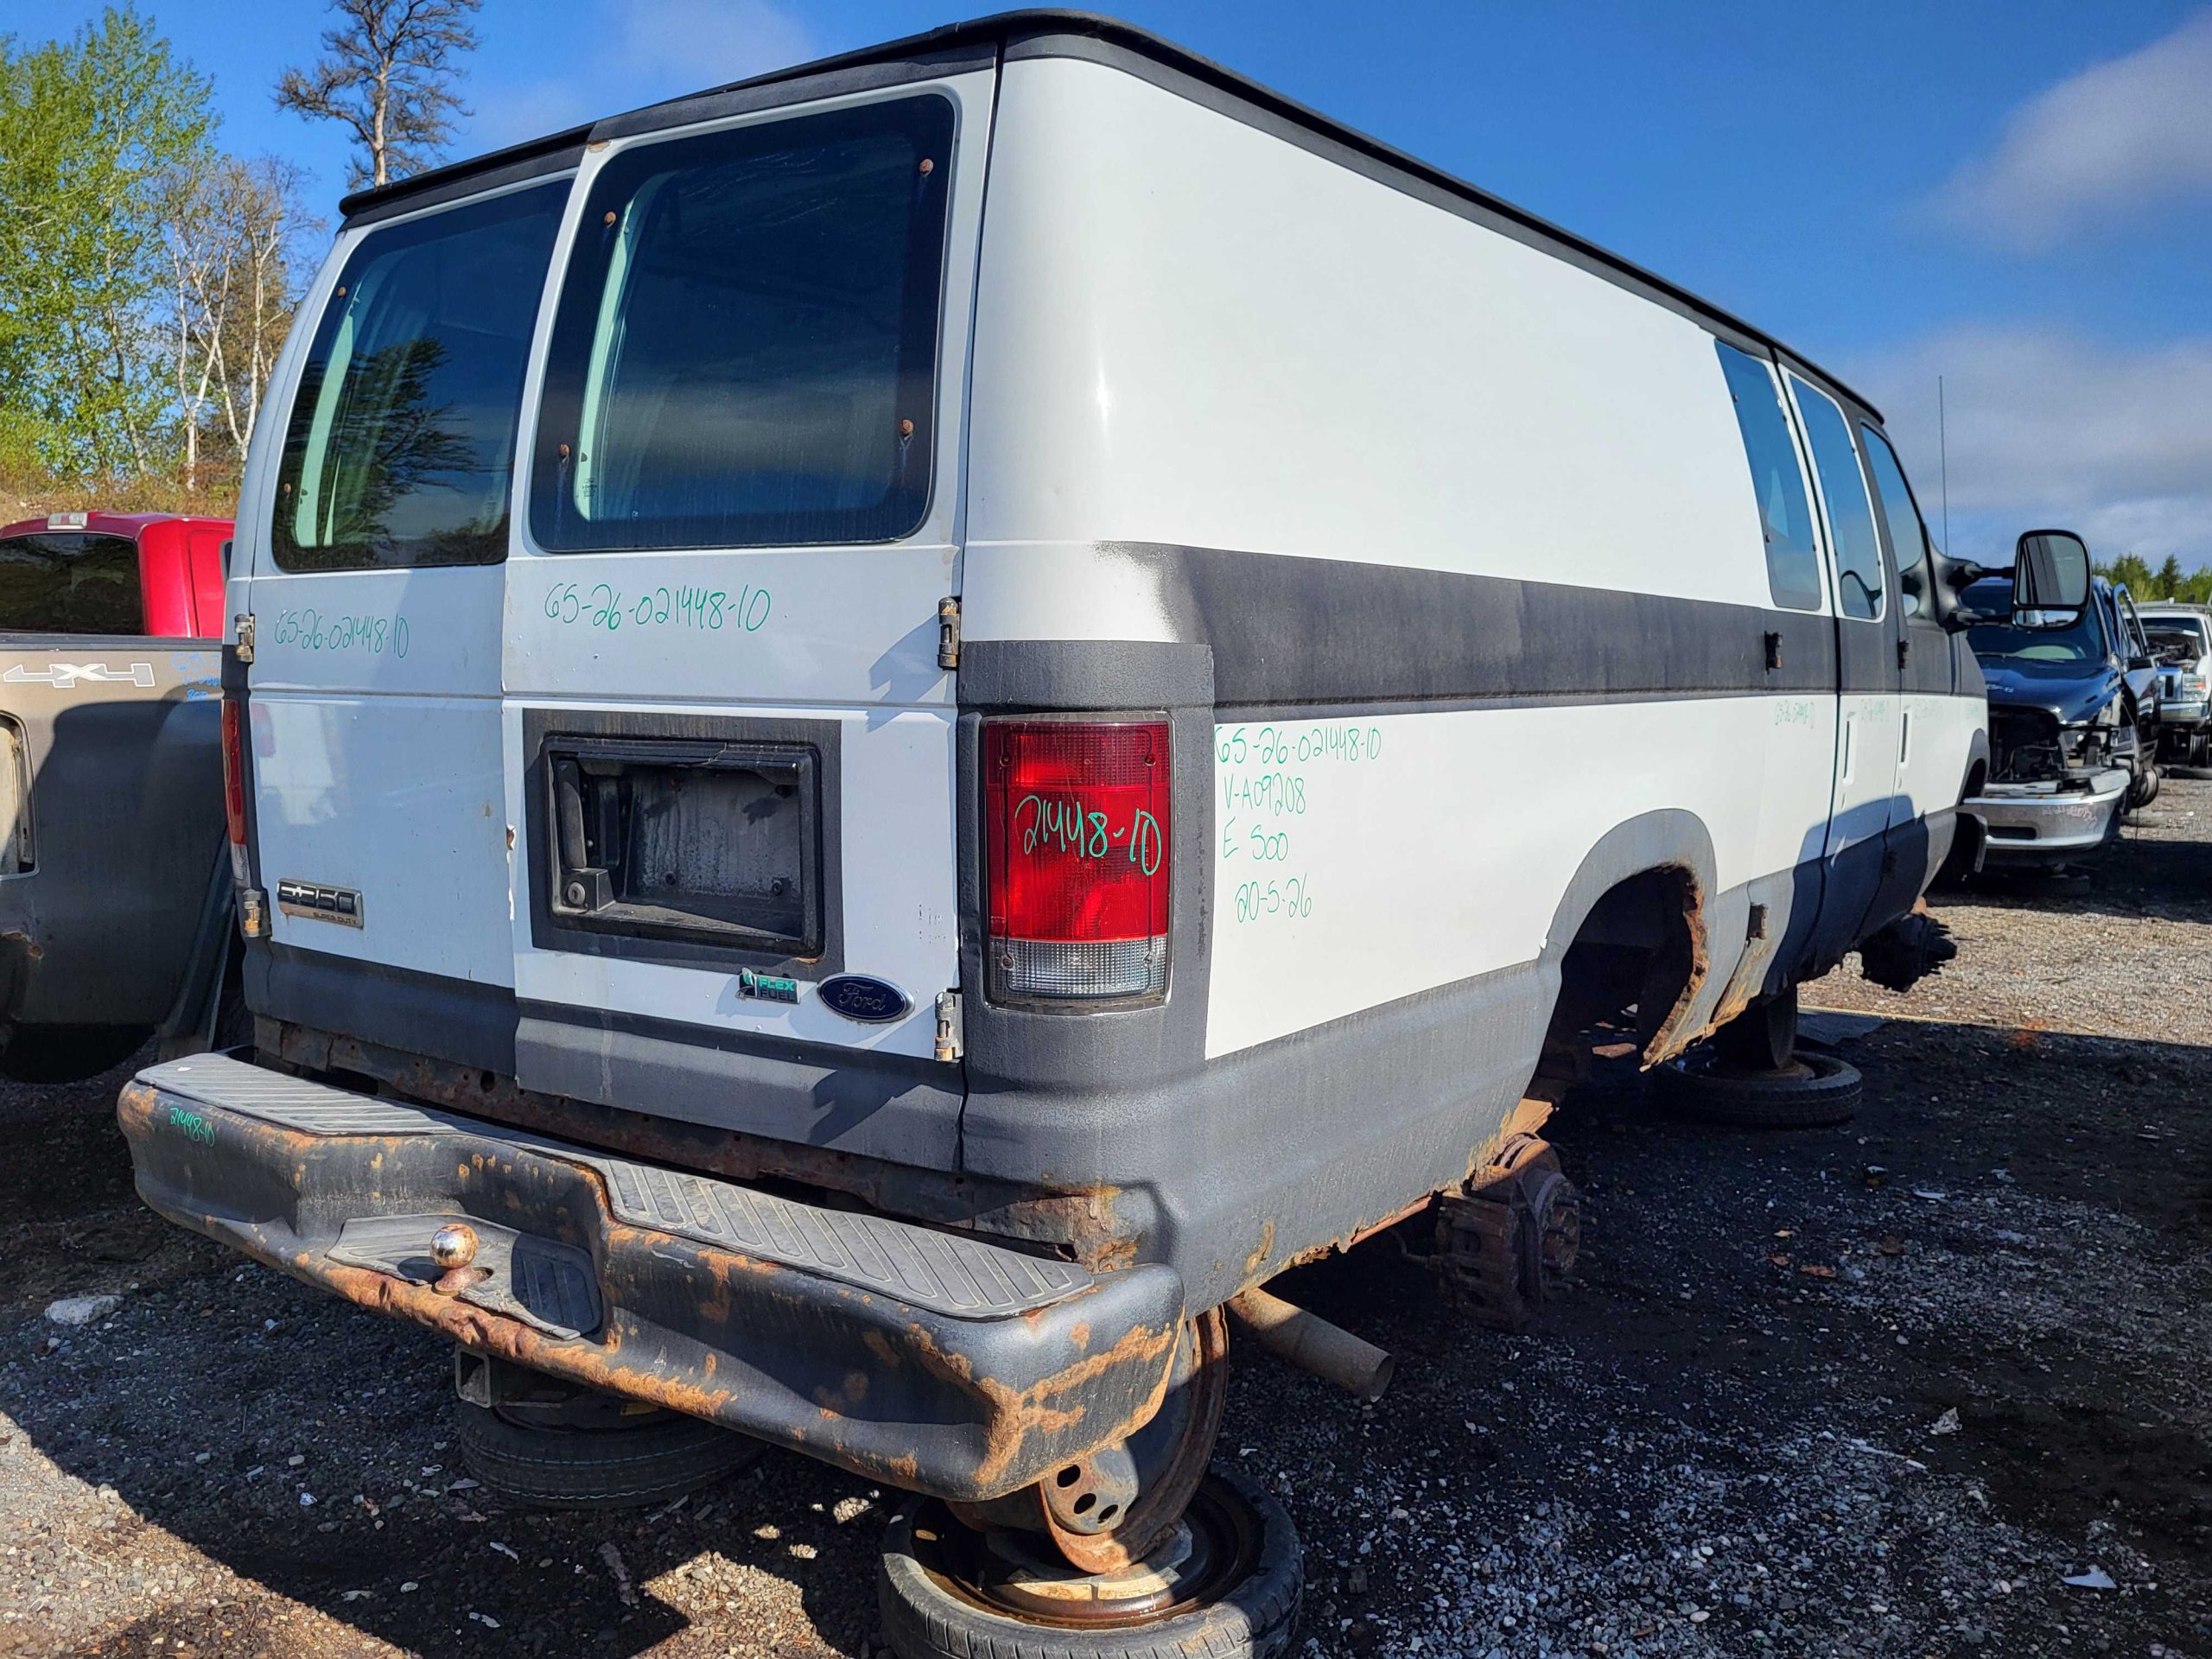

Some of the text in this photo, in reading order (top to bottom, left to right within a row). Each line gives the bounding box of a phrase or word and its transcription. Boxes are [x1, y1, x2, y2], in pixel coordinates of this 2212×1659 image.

[545, 583, 770, 631] 65-26-021448-10
[1014, 794, 1161, 875] 21448-10
[1224, 817, 1239, 858] E
[760, 978, 795, 991] FLEX
[760, 989, 796, 1001] FUEL
[838, 982, 887, 1011] Ford
